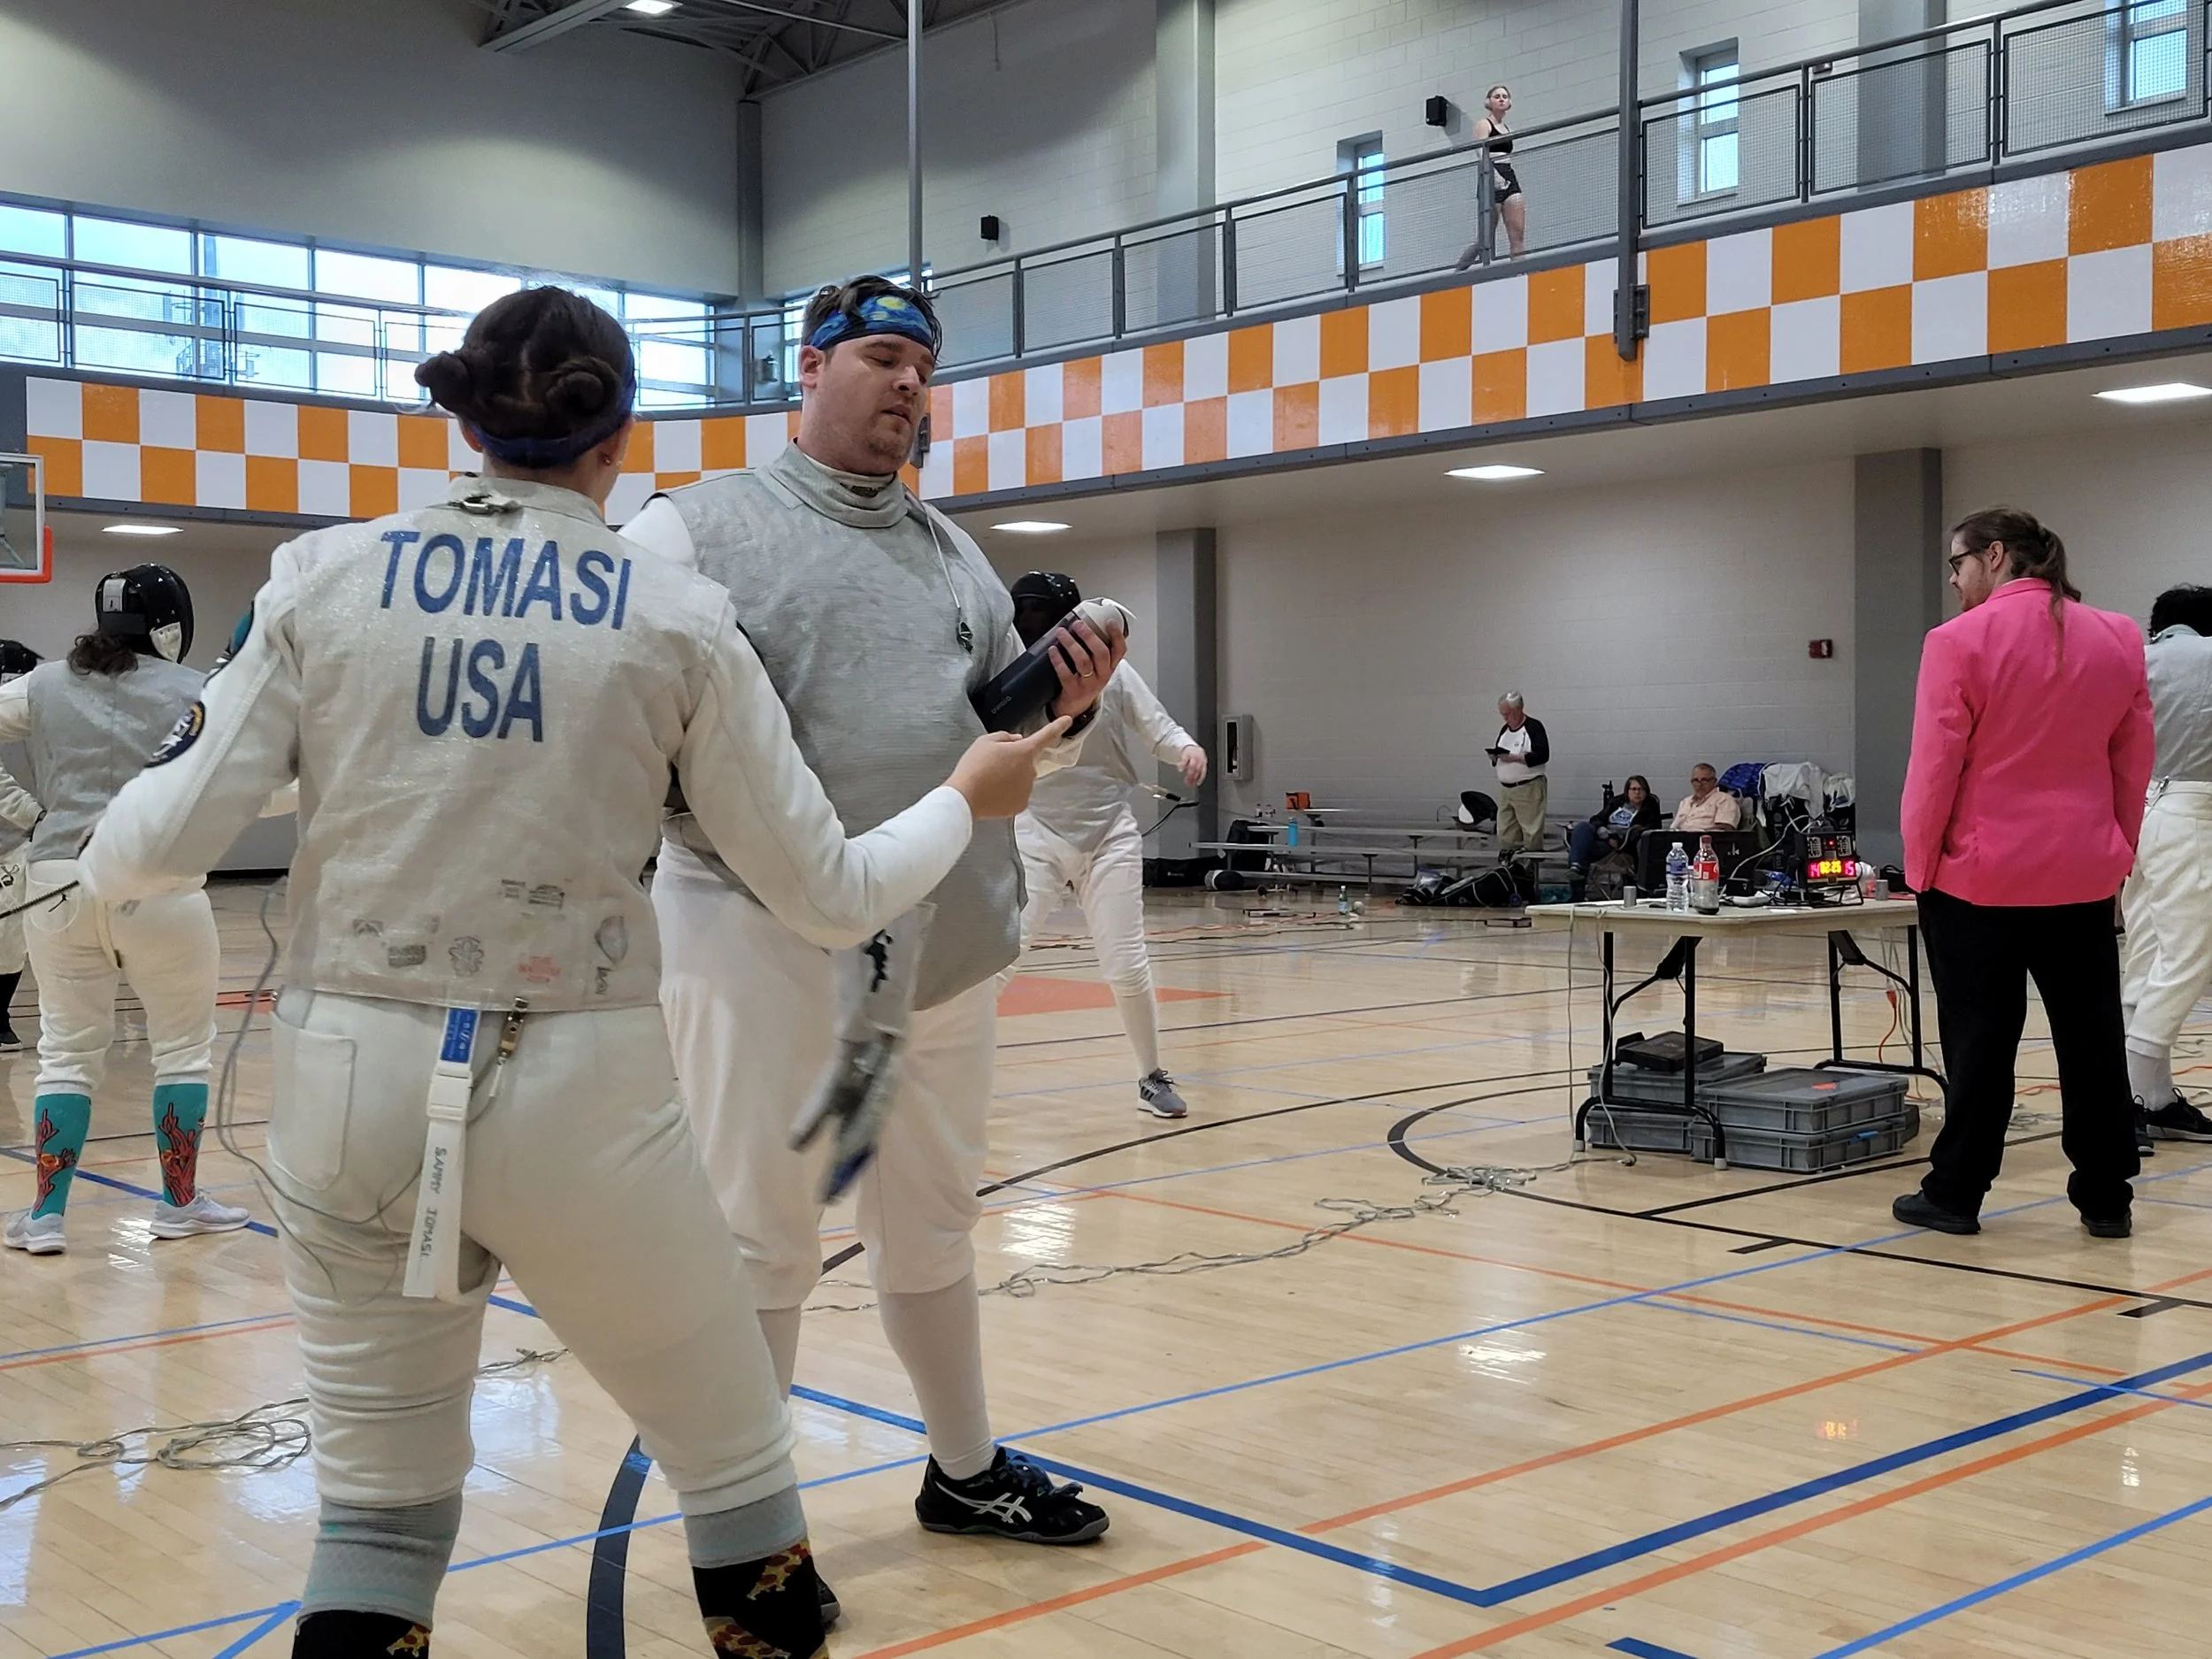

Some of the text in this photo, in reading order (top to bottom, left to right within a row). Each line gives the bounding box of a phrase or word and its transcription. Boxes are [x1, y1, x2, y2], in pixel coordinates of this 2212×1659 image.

[380, 530, 632, 631] TOMASI
[417, 635, 543, 743] USA
[420, 1147, 447, 1256] SAMMY TOMASI
